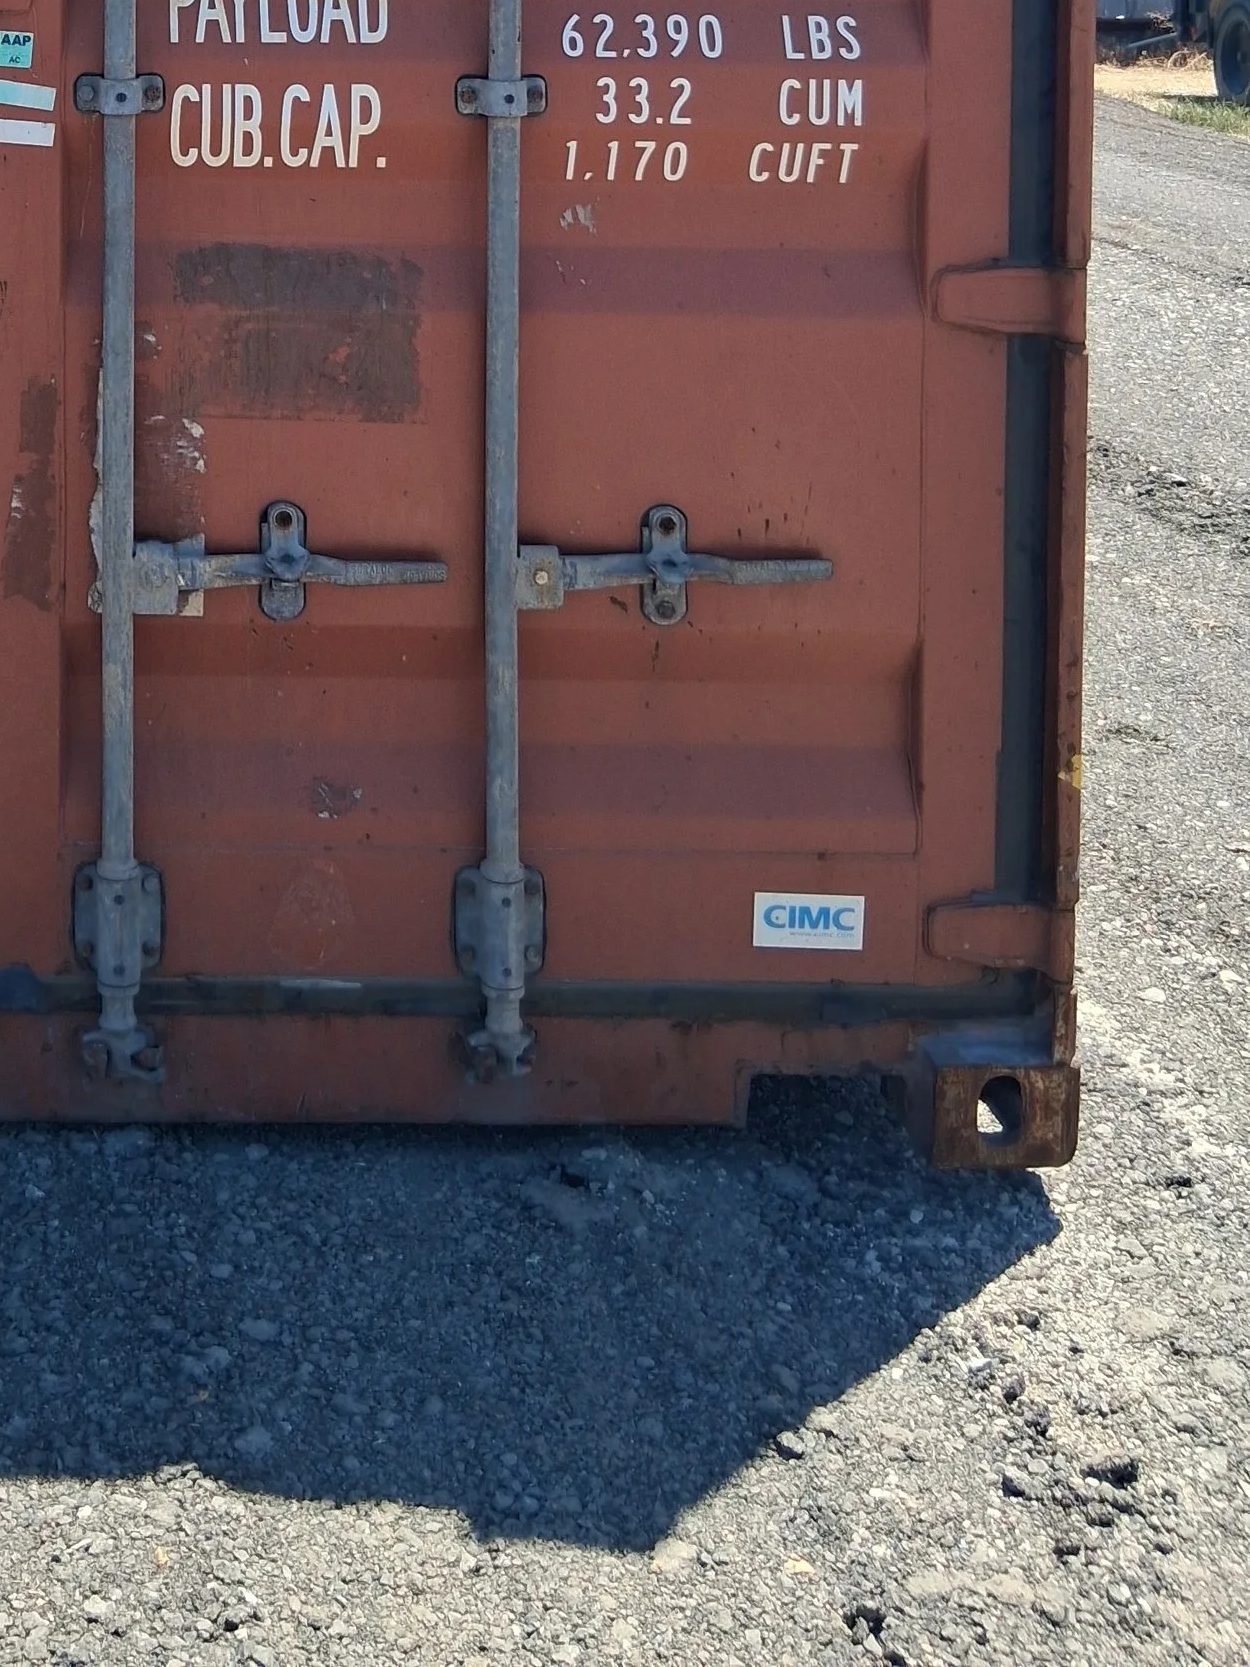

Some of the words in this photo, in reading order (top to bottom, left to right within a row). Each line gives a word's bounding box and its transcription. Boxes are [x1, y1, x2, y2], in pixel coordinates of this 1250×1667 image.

[0, 33, 32, 46] AAP
[561, 13, 723, 59] 62,390
[783, 14, 862, 61] LBS
[169, 83, 387, 168] CUB.CAP.
[595, 76, 692, 125] 33.2
[779, 78, 863, 126] CUM
[565, 140, 688, 182] 1,170
[749, 141, 859, 184] CUFT
[762, 904, 856, 931] CIMC
